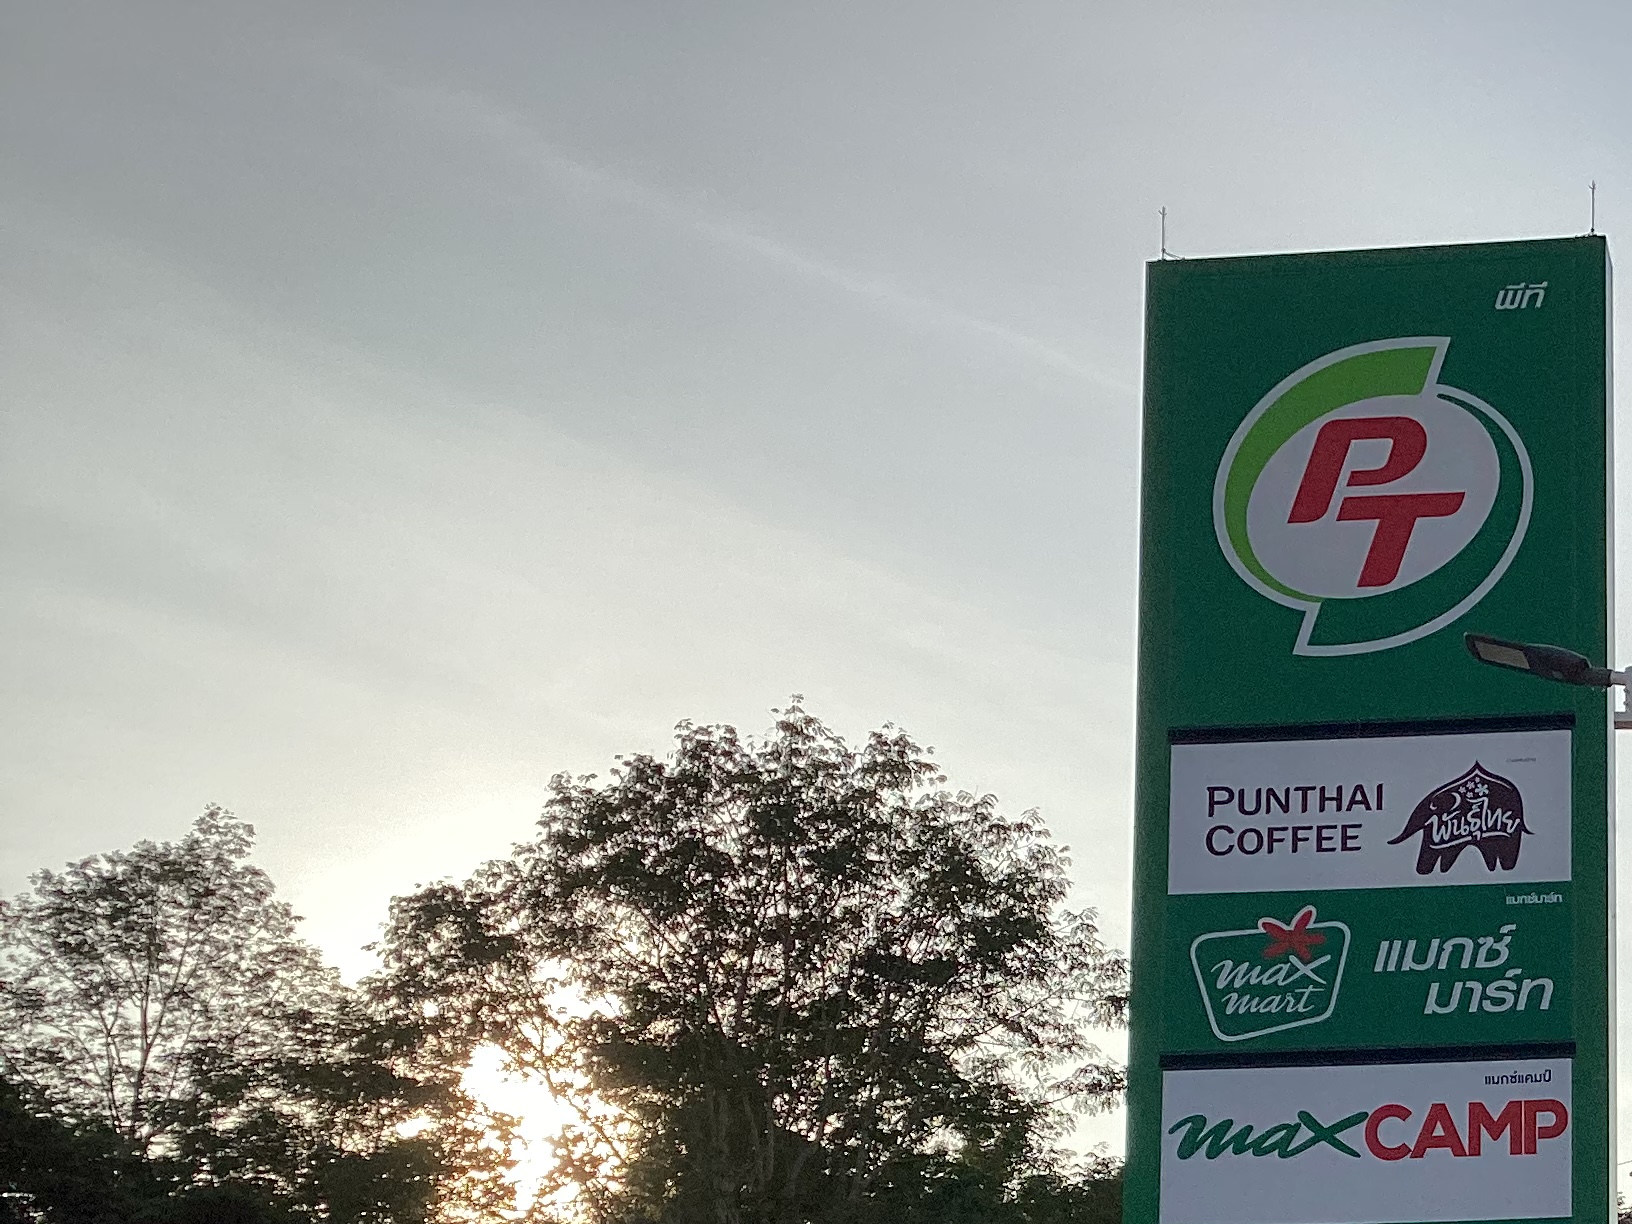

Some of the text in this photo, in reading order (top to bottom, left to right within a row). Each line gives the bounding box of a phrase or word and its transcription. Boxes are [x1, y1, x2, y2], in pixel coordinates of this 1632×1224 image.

[1494, 281, 1548, 310] พีที
[1287, 416, 1465, 587] PT
[1206, 783, 1384, 817] PUNTHAI
[1425, 797, 1520, 843] พันธุ์ไทย
[1205, 823, 1363, 856] COFFEE
[1374, 924, 1516, 972] แมกซ์
[1225, 984, 1325, 1015] mart
[1424, 968, 1554, 1015] มาร์ท
